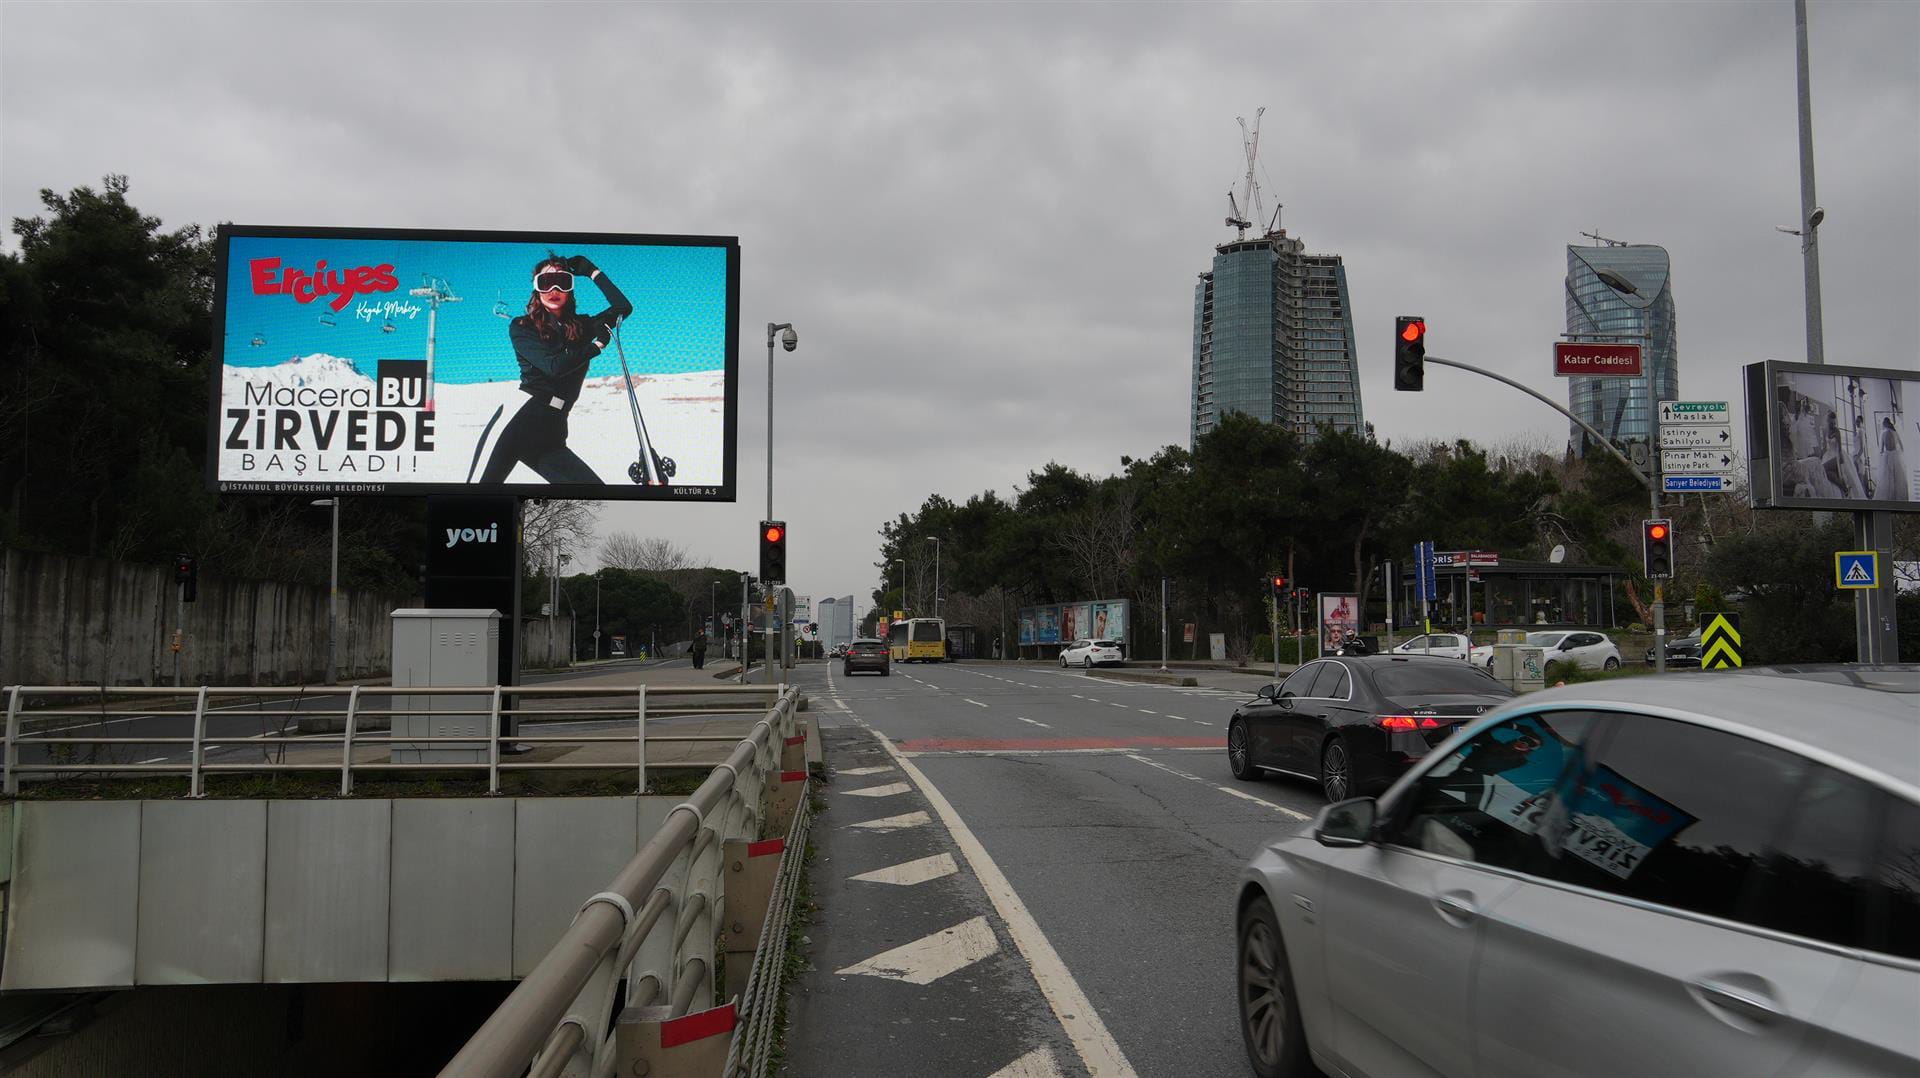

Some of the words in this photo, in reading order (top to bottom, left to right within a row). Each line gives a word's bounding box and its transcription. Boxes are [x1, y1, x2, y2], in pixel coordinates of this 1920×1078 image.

[250, 256, 399, 312] Erciyes
[356, 301, 382, 322] Kayak
[384, 300, 422, 320] Merkezi
[1564, 354, 1591, 365] Katar
[1594, 355, 1633, 365] Caddesi
[245, 381, 370, 407] Macera
[381, 377, 422, 406] BU
[1673, 412, 1714, 420] Maslak
[1662, 438, 1711, 446] Sahilyolu
[242, 453, 417, 476] BAŞLADI!
[1692, 461, 1710, 469] Park
[228, 483, 271, 491] İSTANBUL
[275, 483, 331, 493] BÜYÜKŞEHİR
[335, 484, 385, 492] BELEDİYESİ
[1689, 478, 1721, 488] Belediyesi
[673, 487, 702, 495] KÜLTÜR
[446, 522, 498, 548] yovi
